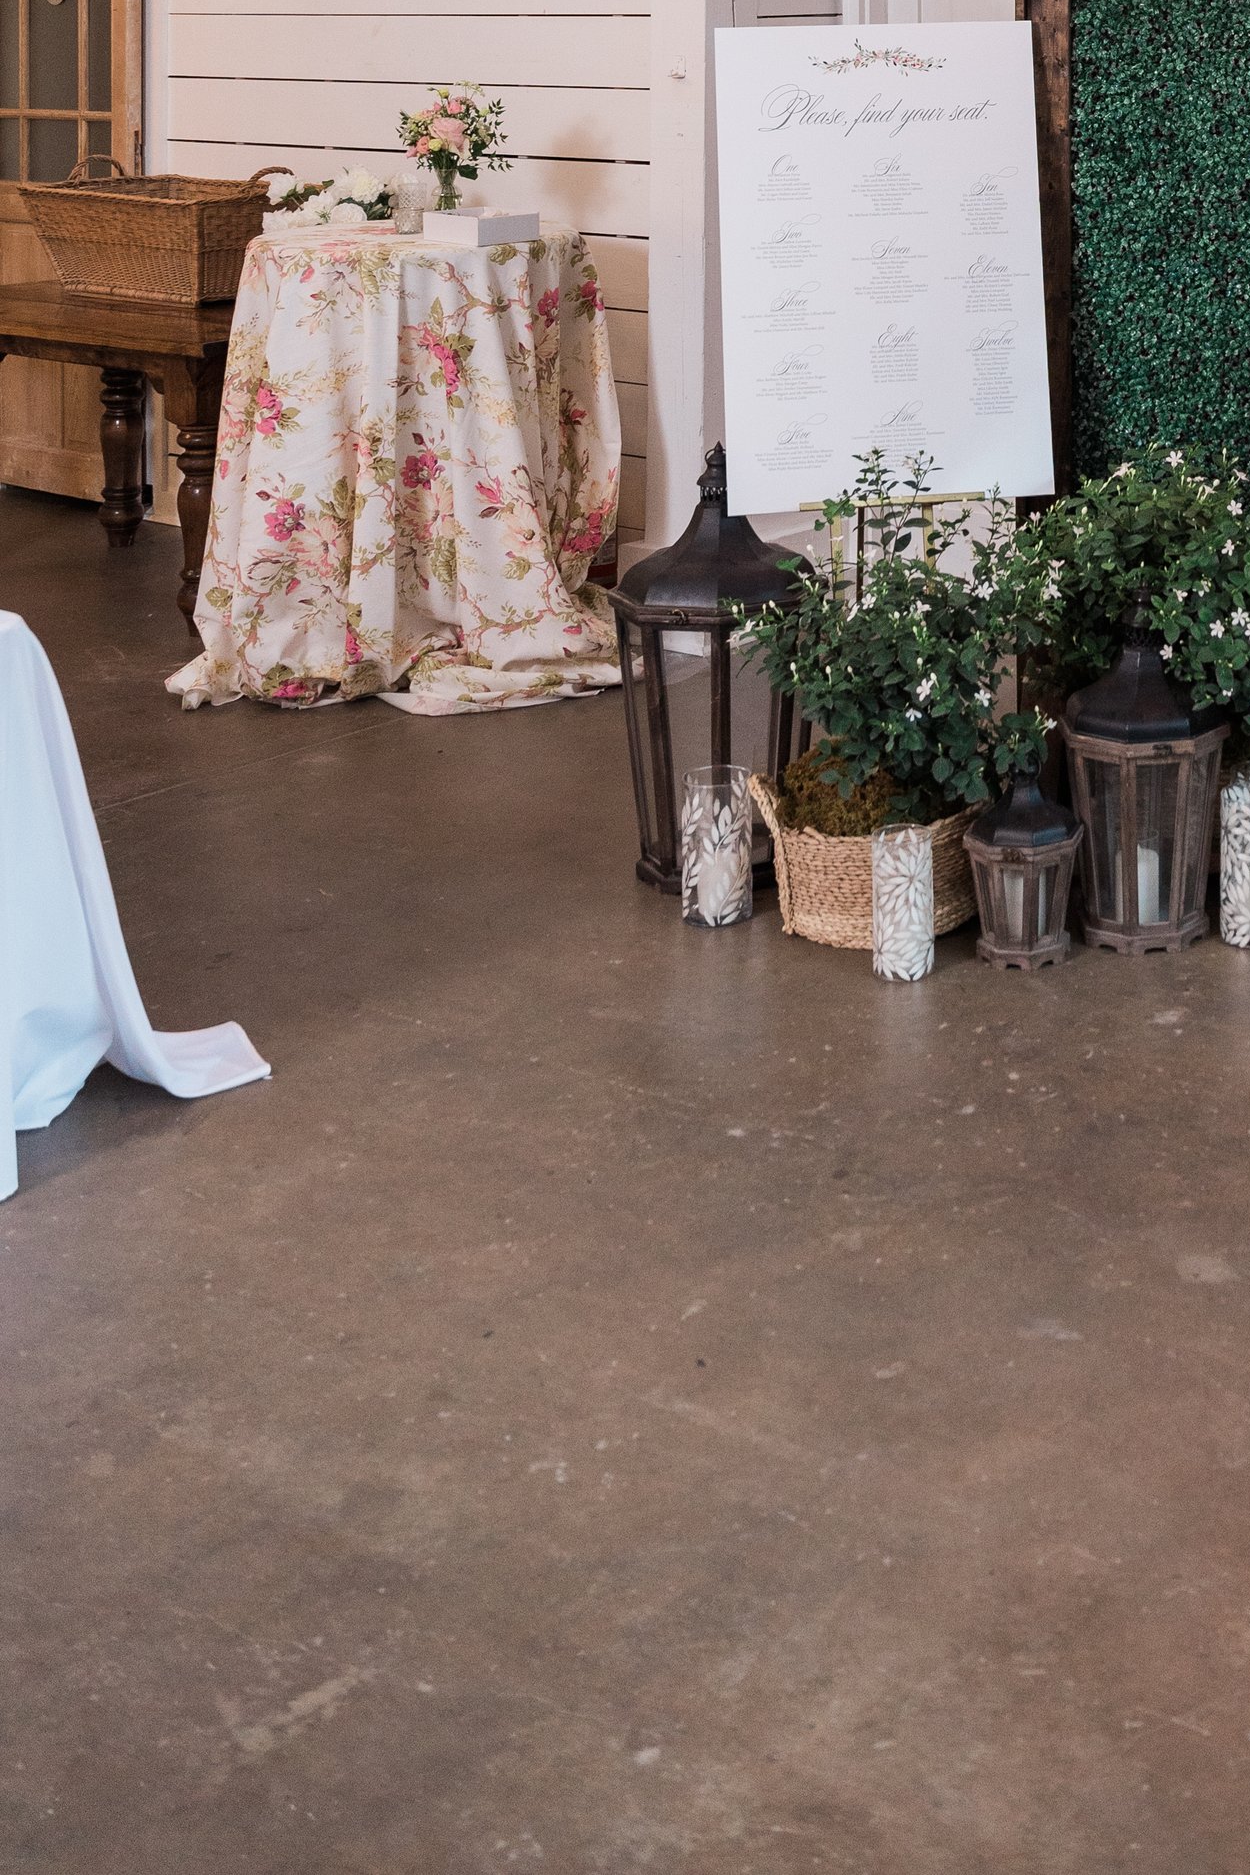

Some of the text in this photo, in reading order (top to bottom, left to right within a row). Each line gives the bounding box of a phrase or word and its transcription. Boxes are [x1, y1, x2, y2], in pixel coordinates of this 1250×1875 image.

[758, 83, 998, 139] Please, find your seat.
[771, 154, 799, 176] One
